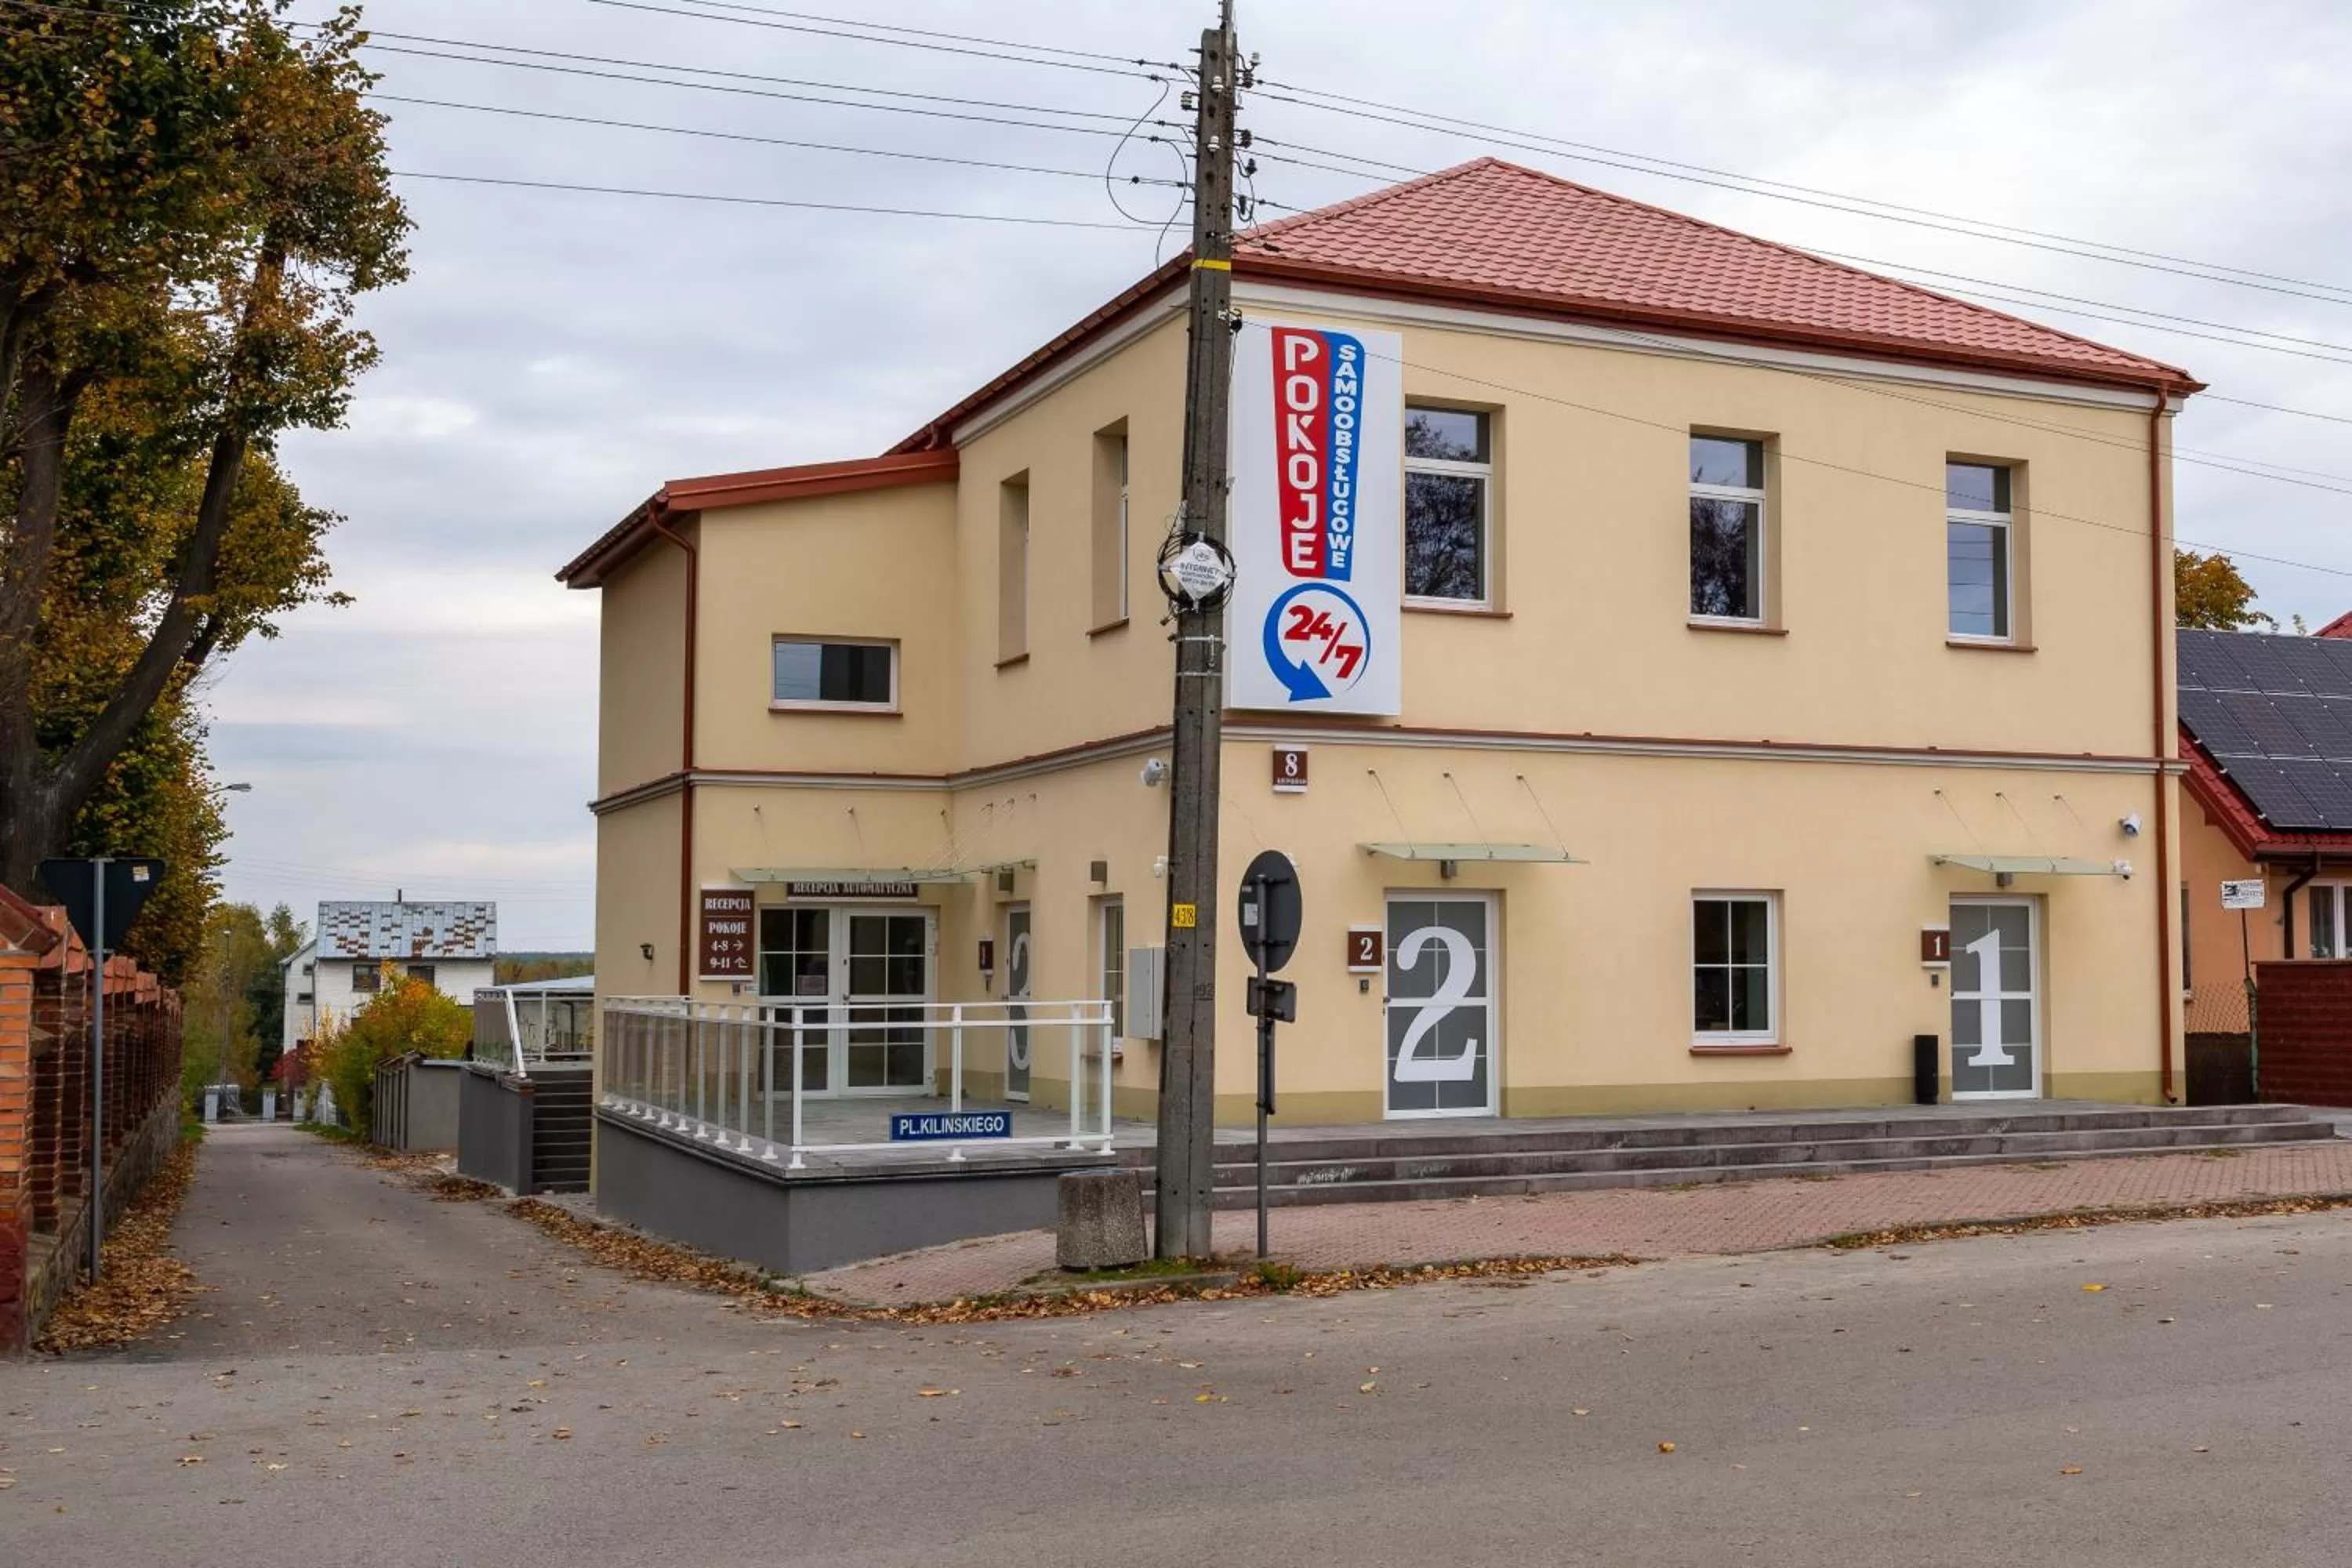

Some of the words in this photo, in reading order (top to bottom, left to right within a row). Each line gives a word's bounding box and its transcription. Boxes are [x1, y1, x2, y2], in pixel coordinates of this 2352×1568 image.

[1283, 336, 1320, 570] POKOJE
[1283, 604, 1363, 679] 24/7
[1286, 753, 1298, 777] 8
[705, 898, 750, 910] RECEPCJA
[709, 921, 746, 935] POKOJE
[1360, 937, 1373, 960] 2
[1934, 936, 1941, 956] 1
[710, 956, 730, 968] 9-11
[1394, 926, 1478, 1082] 2
[1966, 928, 2014, 1065] 1
